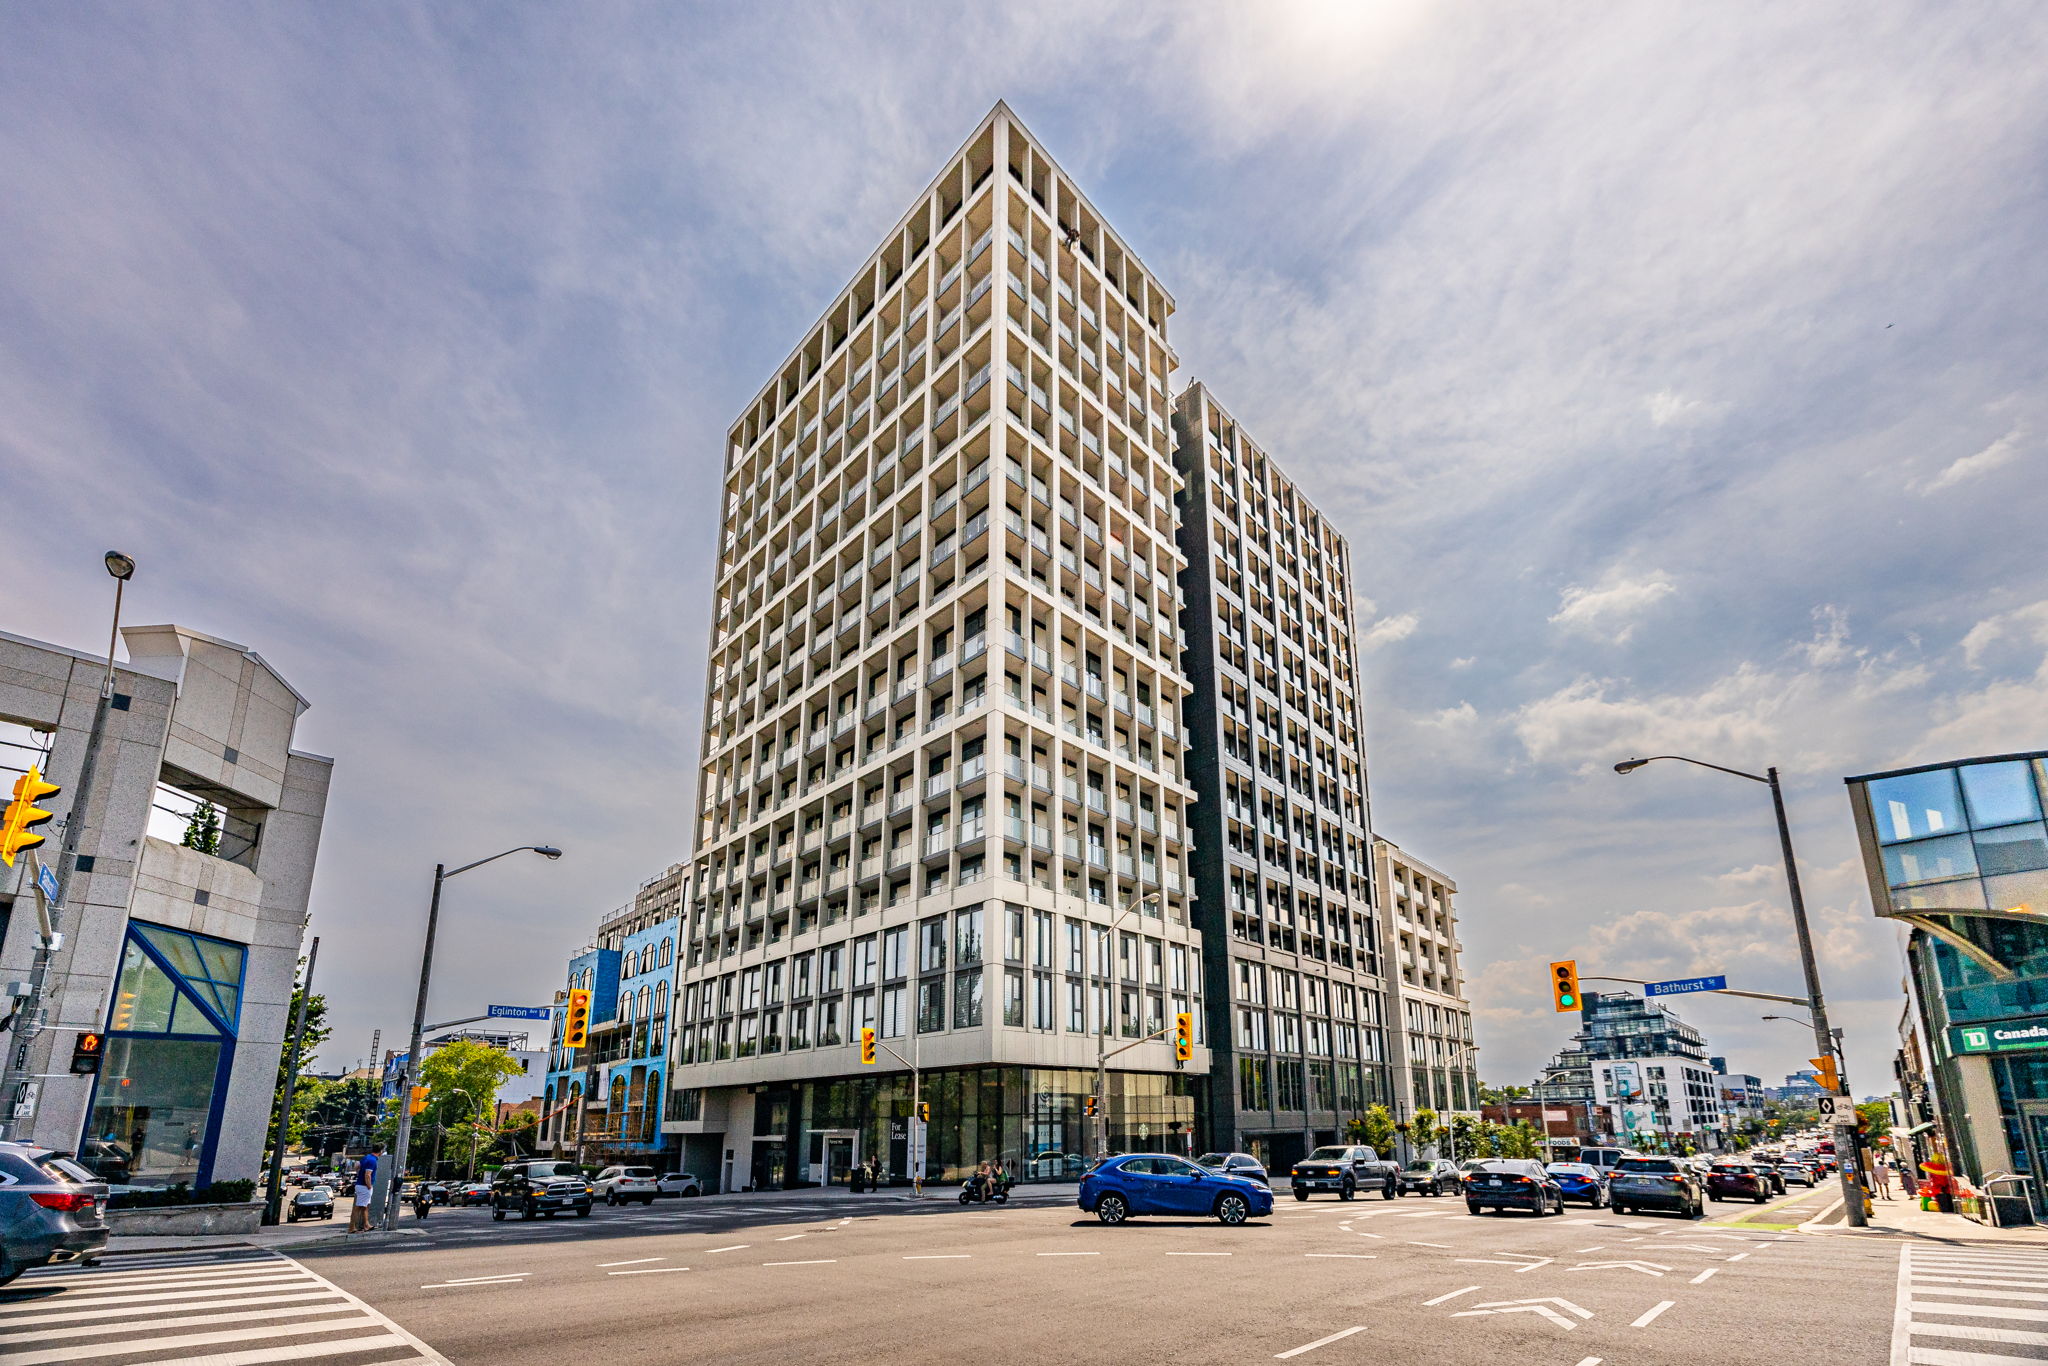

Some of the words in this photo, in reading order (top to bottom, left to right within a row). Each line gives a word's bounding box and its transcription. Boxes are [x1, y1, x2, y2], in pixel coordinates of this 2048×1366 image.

[1654, 980, 1705, 994] Bathurst
[491, 1005, 527, 1017] Eglinton
[538, 1009, 547, 1018] W
[1964, 1031, 1987, 1047] TD
[1994, 1025, 2048, 1040] Canada
[891, 1122, 902, 1131] For
[891, 1131, 907, 1140] Lease
